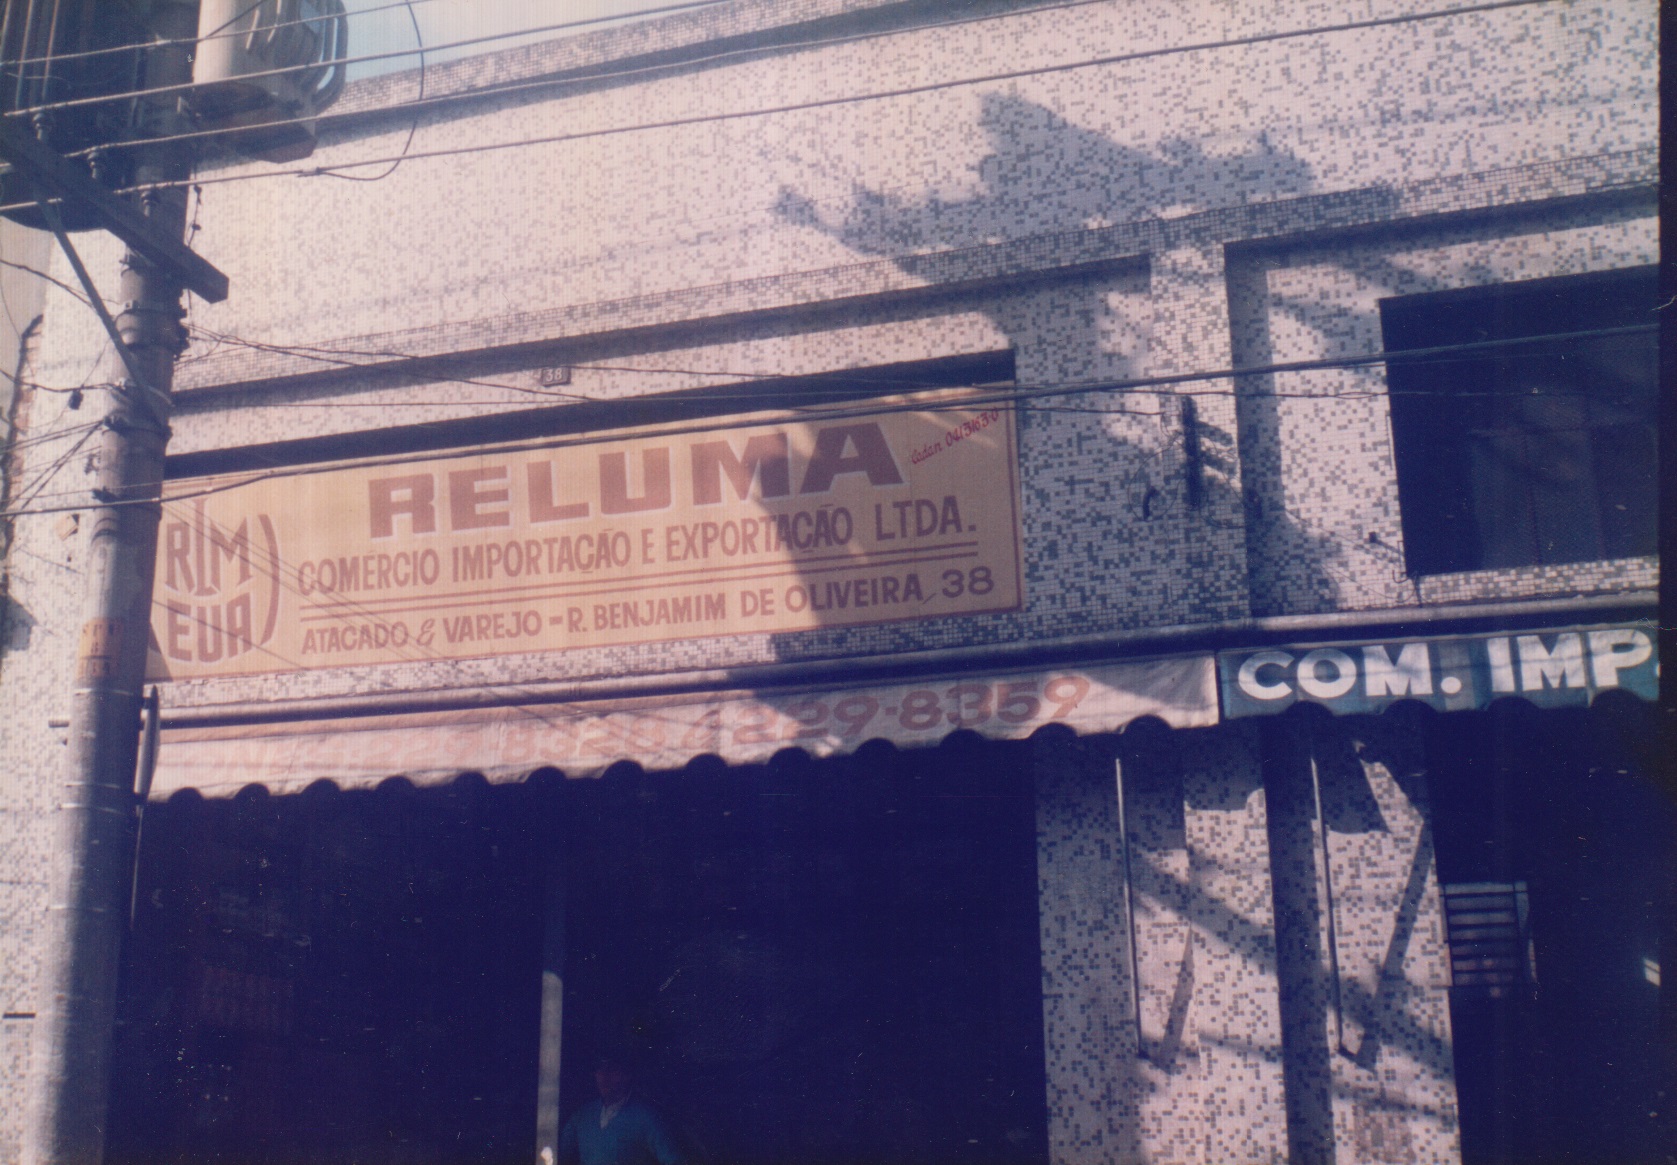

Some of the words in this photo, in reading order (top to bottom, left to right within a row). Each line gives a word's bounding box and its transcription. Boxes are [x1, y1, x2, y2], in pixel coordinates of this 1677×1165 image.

[545, 368, 563, 382] 38
[368, 421, 904, 539] RELUMA
[641, 528, 655, 565] E
[875, 495, 978, 541] LTDA.
[301, 621, 409, 655] ATACADO
[443, 609, 543, 644] VAREJO
[593, 592, 726, 632] BENJAMIM
[740, 590, 774, 619] DE
[942, 566, 995, 599] 38
[1238, 642, 1462, 700] COM.
[732, 675, 1091, 745] 229-8359
